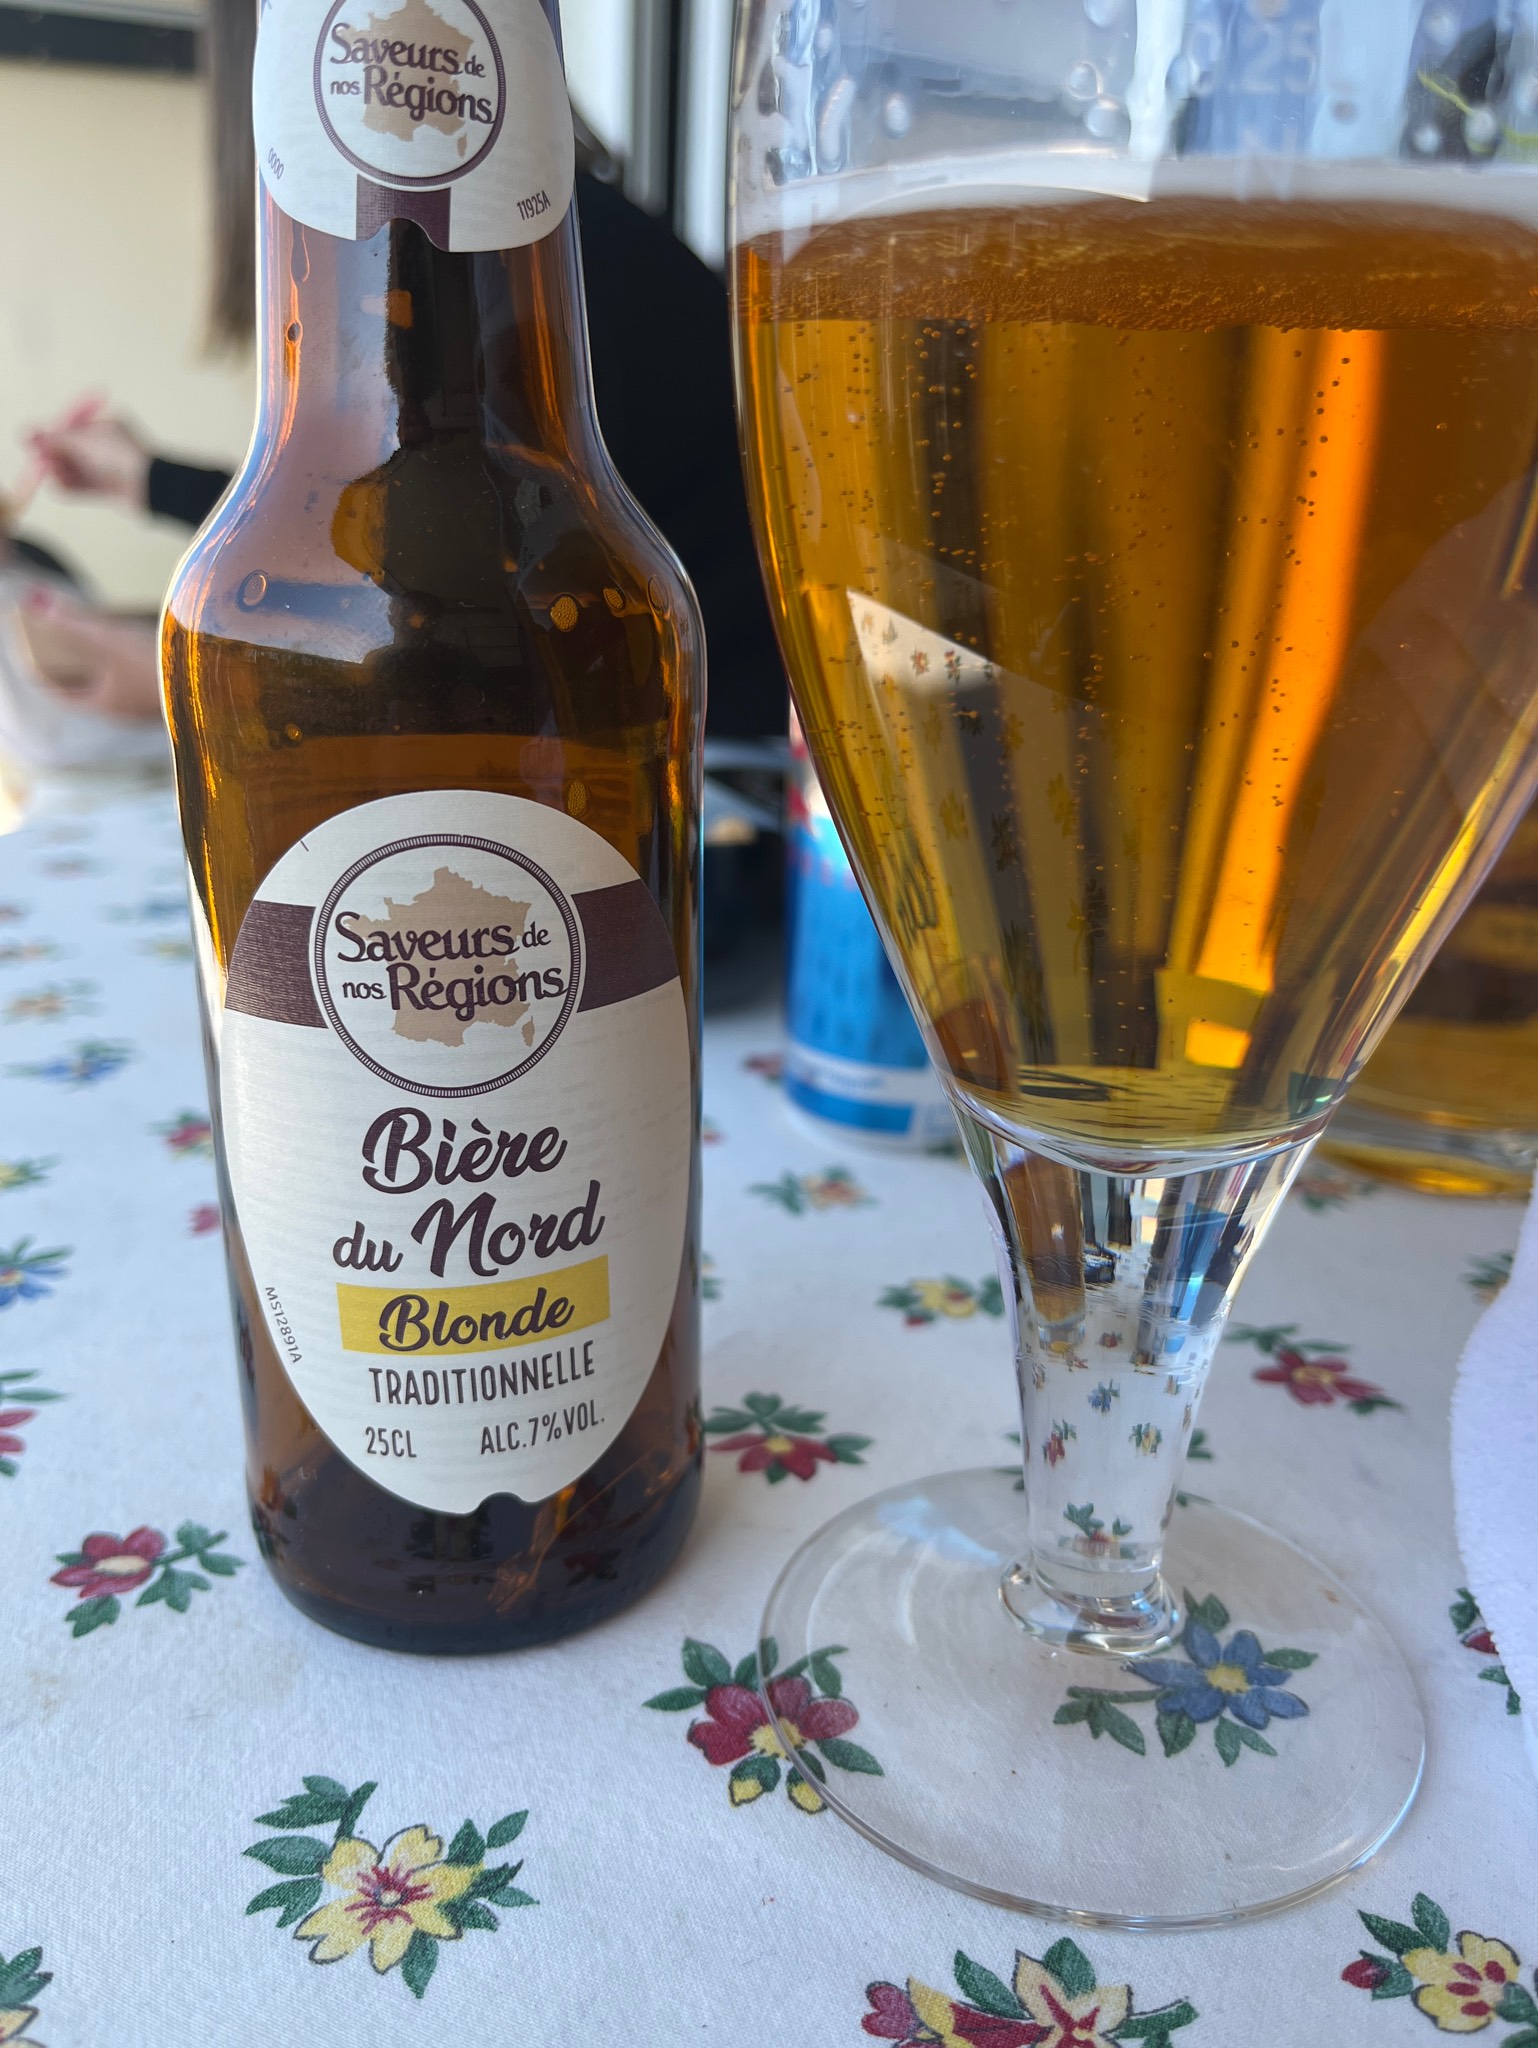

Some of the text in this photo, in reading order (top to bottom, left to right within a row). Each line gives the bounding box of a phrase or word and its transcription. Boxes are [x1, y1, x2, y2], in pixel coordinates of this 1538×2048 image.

[330, 23, 487, 79] Saveurs de
[330, 65, 497, 124] nos Régions
[517, 190, 551, 220] 11925A
[336, 911, 552, 962] Saveurs de
[342, 962, 569, 1021] nos Régions
[362, 1107, 568, 1195] Bière
[333, 1180, 606, 1278] du Nord
[265, 1286, 303, 1364] MS12891A
[379, 1287, 576, 1352] Blonde
[369, 1340, 596, 1405] TRADITIONNELLE
[366, 1427, 417, 1459] 25CL
